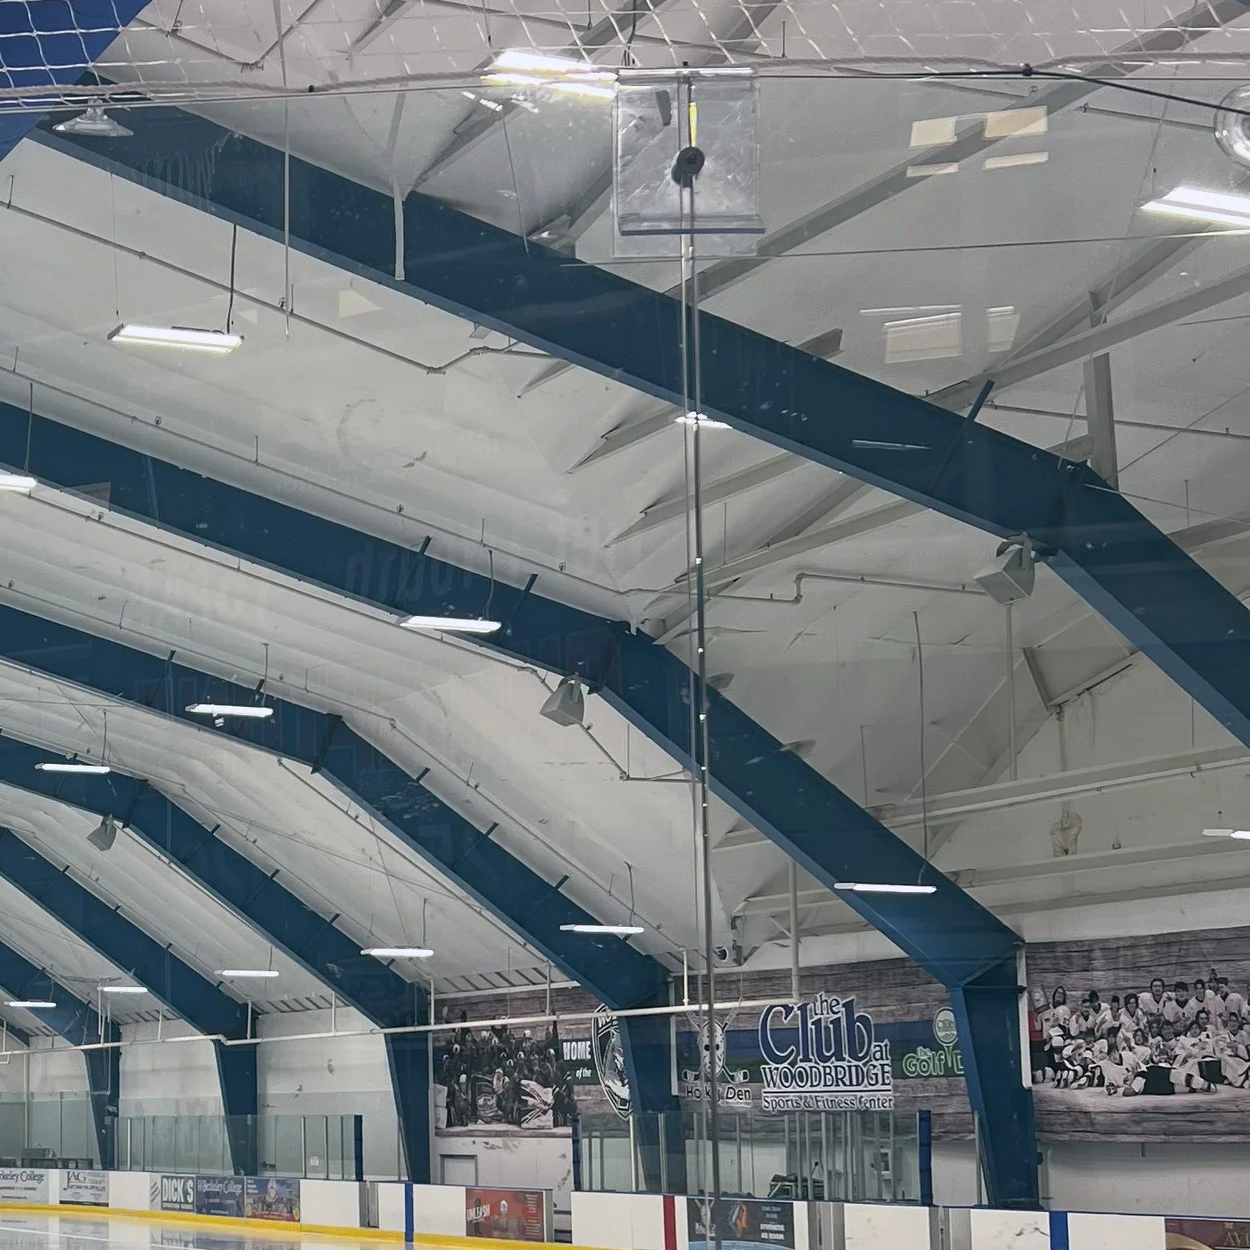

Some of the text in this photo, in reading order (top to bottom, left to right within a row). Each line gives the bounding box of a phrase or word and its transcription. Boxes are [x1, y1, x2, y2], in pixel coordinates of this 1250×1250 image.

[813, 994, 840, 1016] the
[760, 997, 890, 1064] Club at
[563, 1041, 591, 1060] HOME
[902, 1050, 945, 1077] Golf
[575, 1068, 591, 1079] of the
[761, 1063, 892, 1089] WOODBRIDGE
[726, 1086, 751, 1101] Den
[763, 1095, 893, 1112] Sports & Fitness Center
[20, 1170, 45, 1184] College
[63, 1171, 86, 1190] JAG
